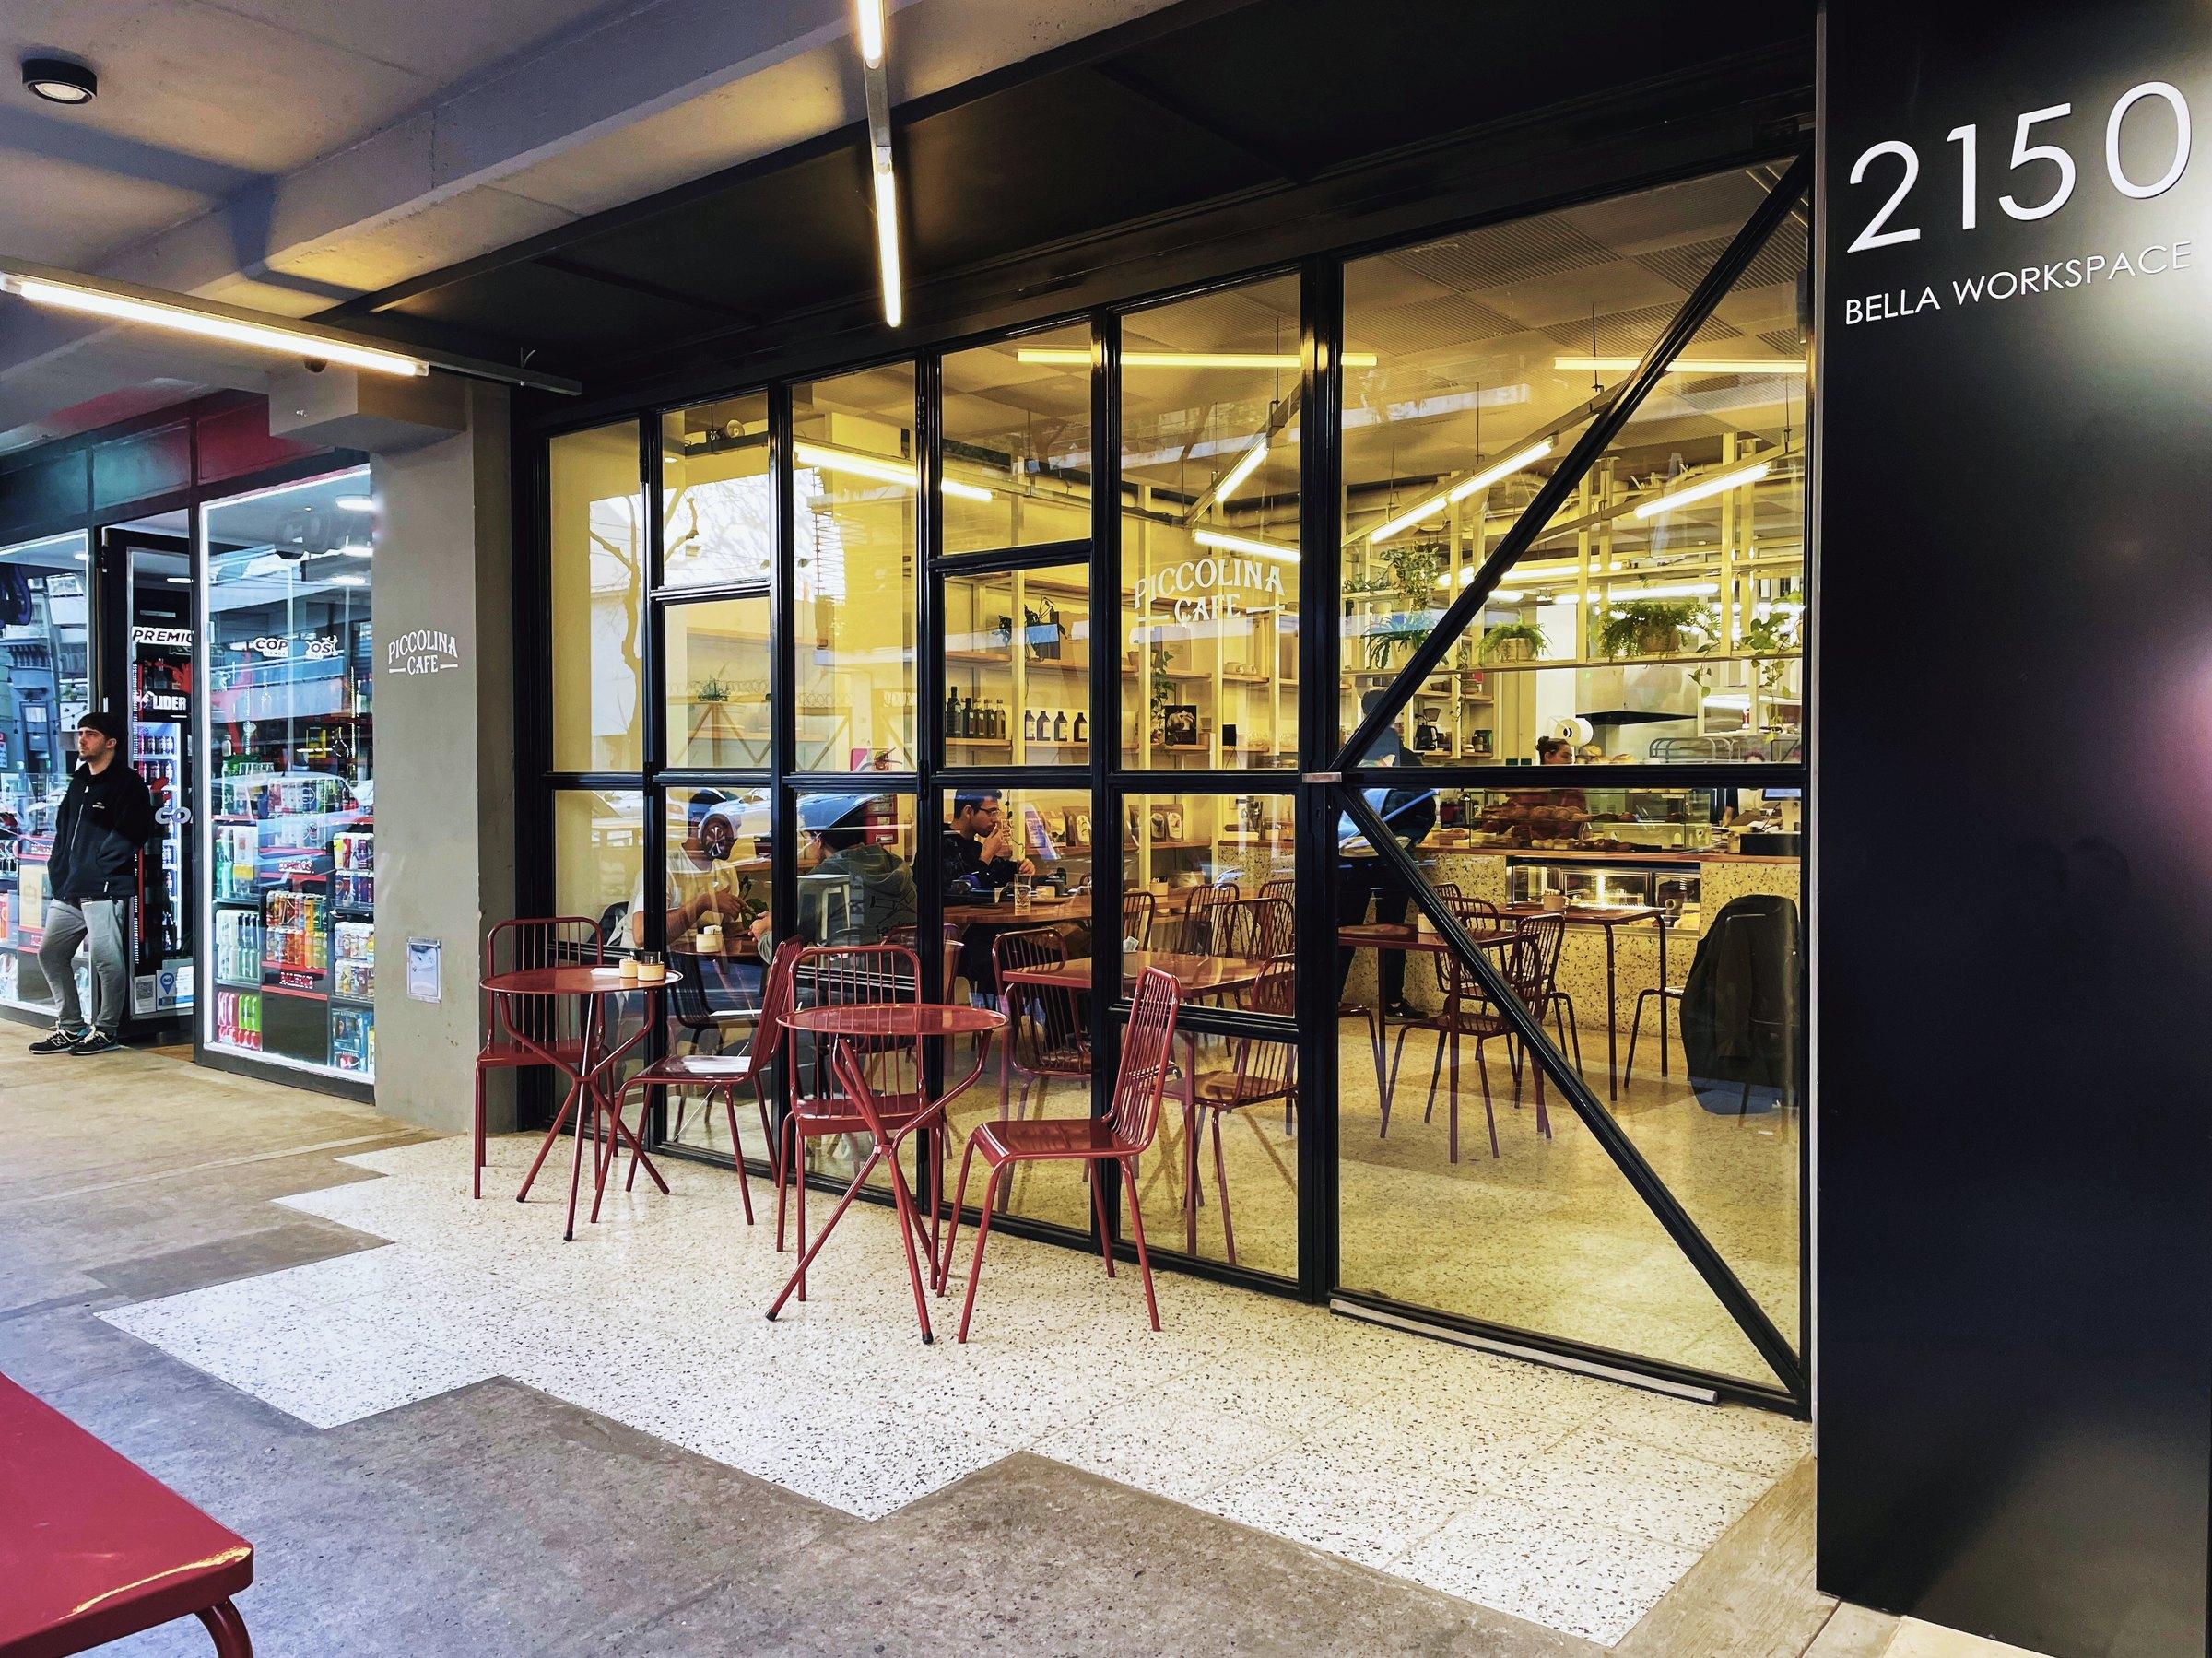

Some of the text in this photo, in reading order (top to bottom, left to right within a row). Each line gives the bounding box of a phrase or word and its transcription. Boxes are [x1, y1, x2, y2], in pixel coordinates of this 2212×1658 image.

[1847, 81, 2192, 253] 2150
[1845, 240, 2192, 325] BELLA WORKSPACE
[1134, 557, 1285, 610] PICCOLINA
[1174, 593, 1241, 626] CAFE
[388, 629, 459, 664] PICCOLINA
[406, 654, 439, 676] CAFE
